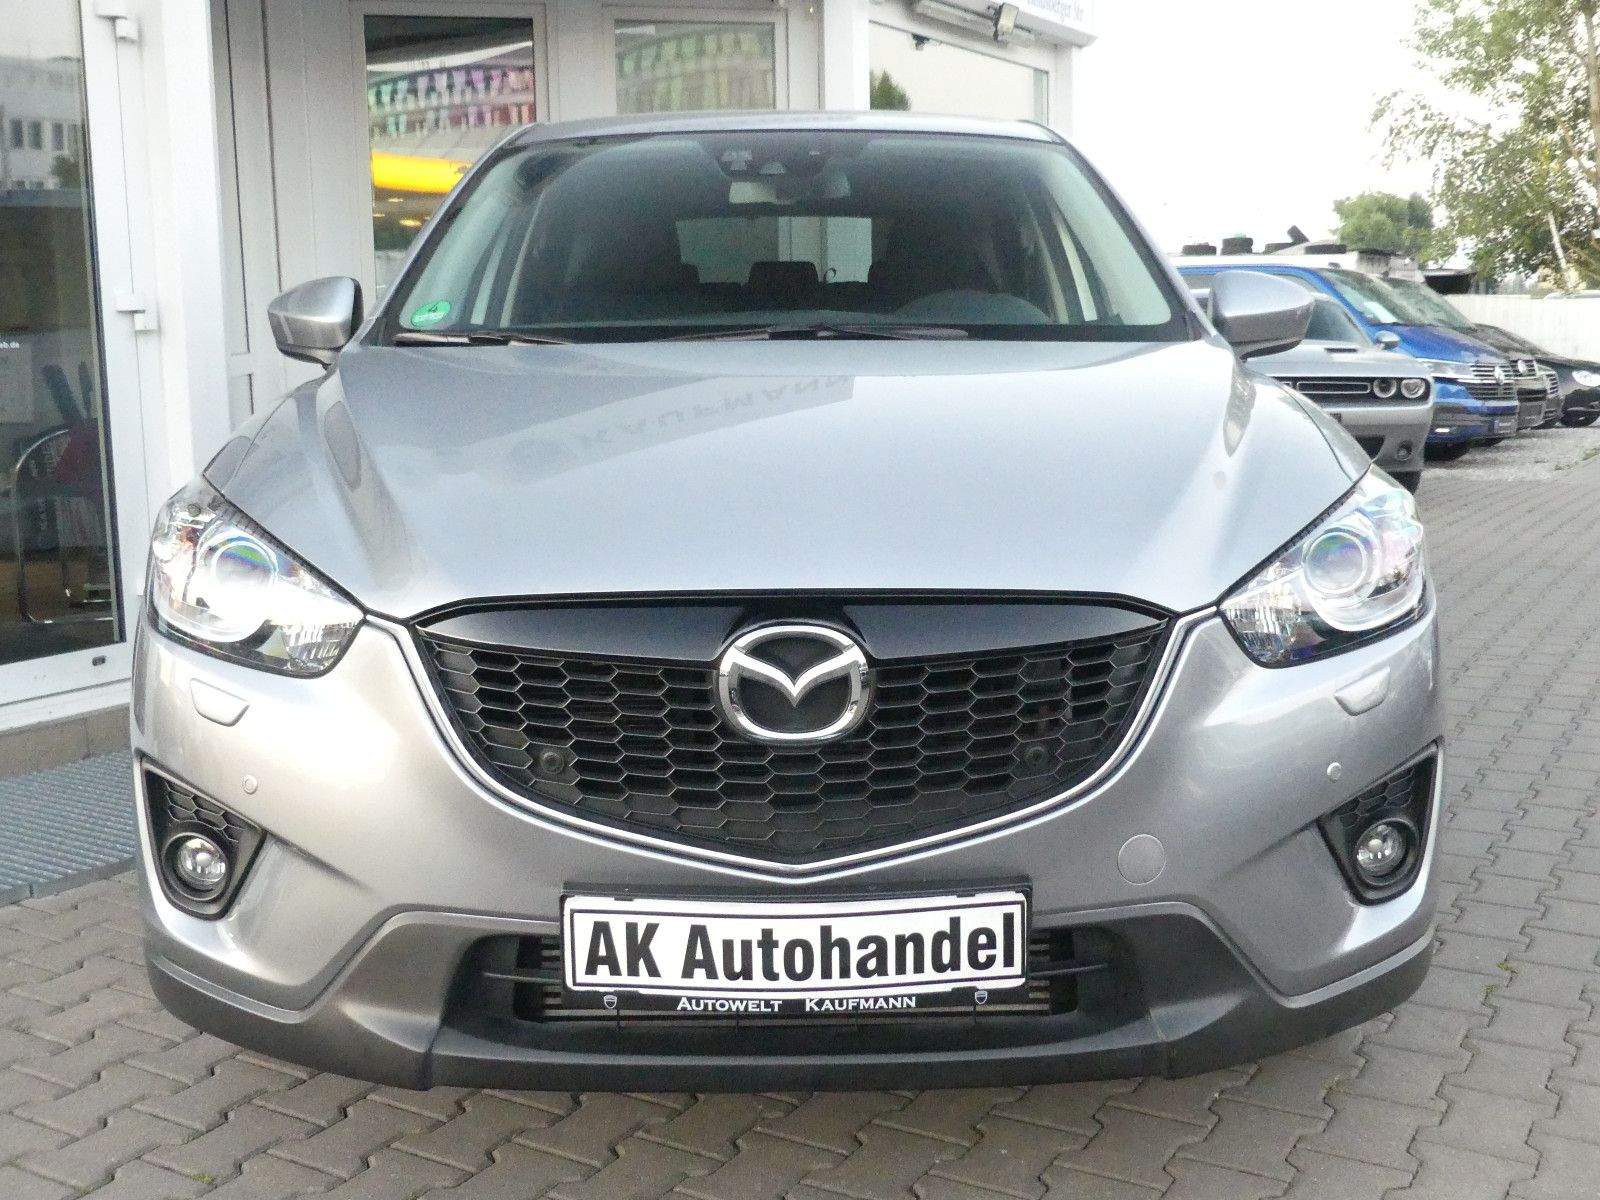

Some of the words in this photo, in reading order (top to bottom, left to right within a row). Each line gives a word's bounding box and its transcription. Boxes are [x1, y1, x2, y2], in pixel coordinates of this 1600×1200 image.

[584, 920, 661, 978] AK
[681, 911, 1015, 981] Autohandel
[677, 996, 782, 1012] AUTOWELT
[805, 996, 916, 1012] KAUFMANN
